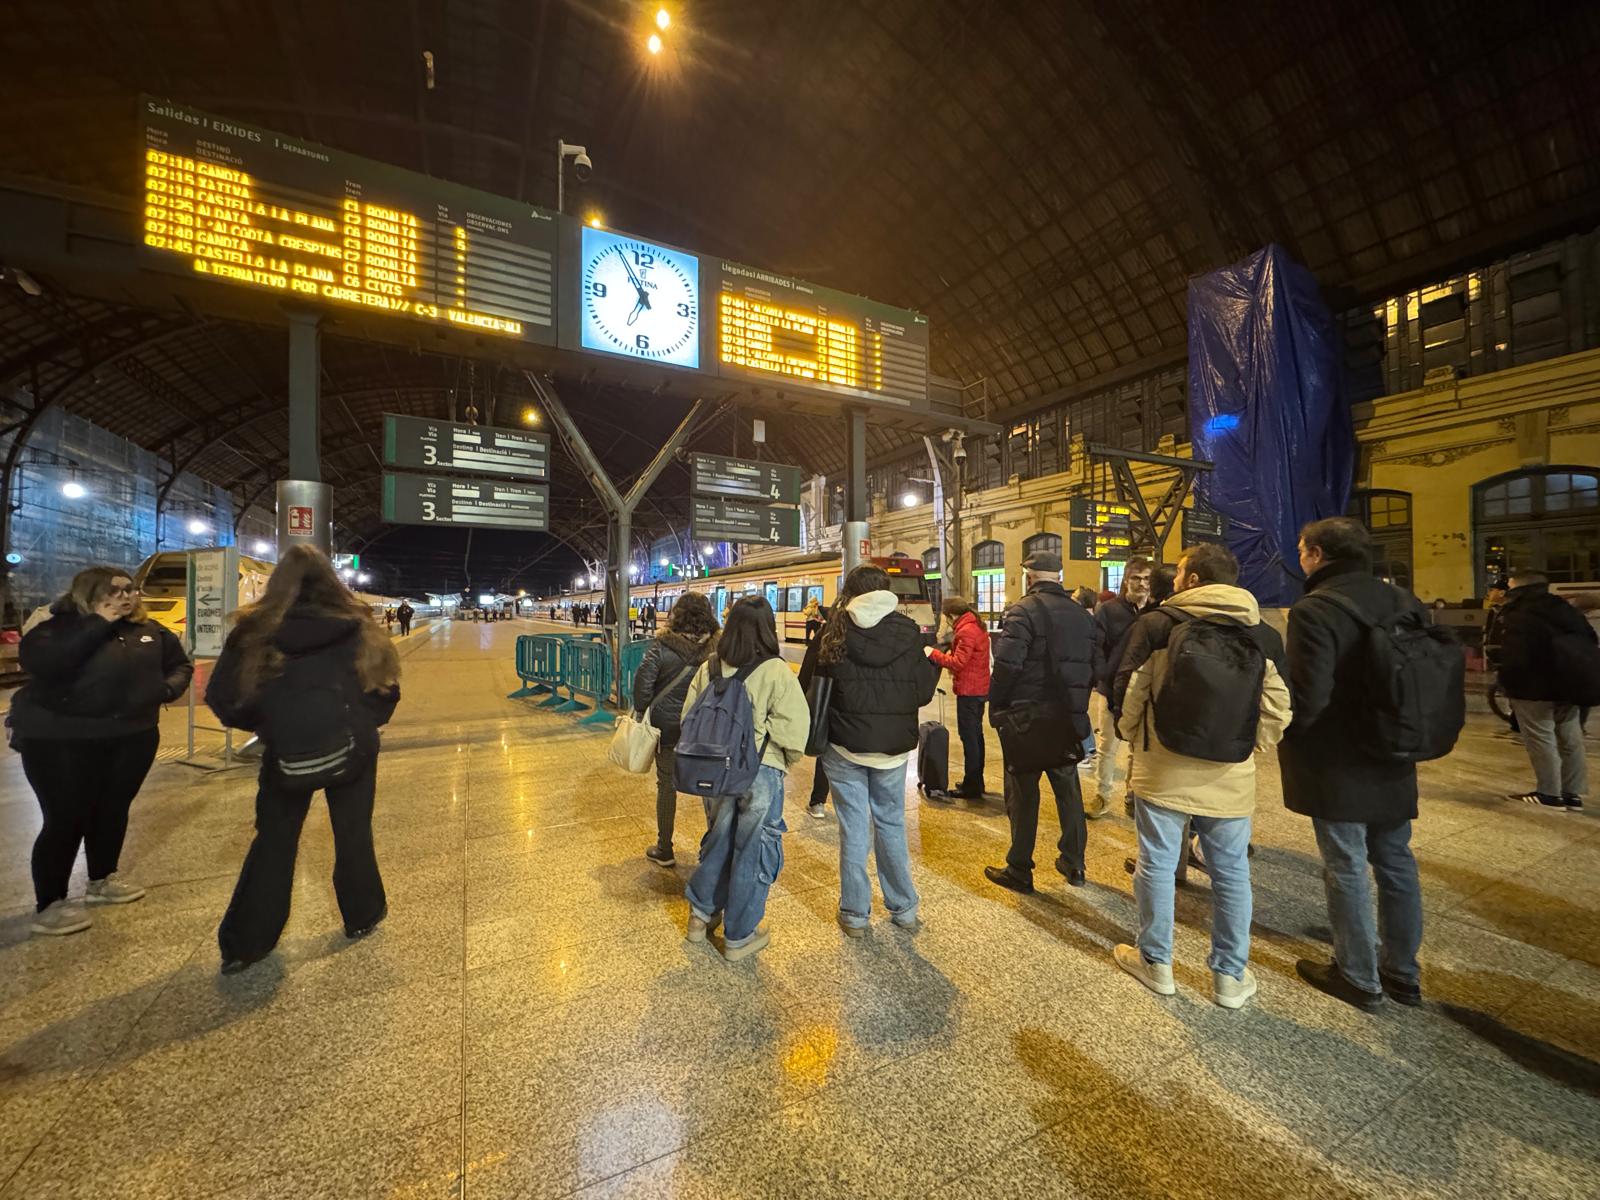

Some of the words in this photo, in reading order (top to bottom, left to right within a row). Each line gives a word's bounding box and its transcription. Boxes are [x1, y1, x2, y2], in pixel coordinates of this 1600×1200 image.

[148, 103, 199, 126] Salidas
[213, 121, 261, 143] EIXIDES
[282, 143, 329, 163] DEPARTURES
[631, 250, 654, 270] 12
[194, 258, 286, 288] ALTERNATIVO
[291, 278, 317, 295] POR
[269, 257, 289, 273] LA
[294, 263, 335, 283] PLANA
[365, 278, 402, 296] CIVIS
[366, 266, 418, 287] RODALIA
[722, 263, 752, 278] Llegadas
[592, 282, 607, 298] 9
[676, 303, 690, 318] 3
[635, 334, 650, 349] 6
[423, 445, 437, 465] 3
[770, 484, 780, 499] 4
[422, 502, 436, 521] 3
[1086, 514, 1093, 526] 5
[770, 527, 780, 542] 4
[1086, 547, 1093, 559] 5
